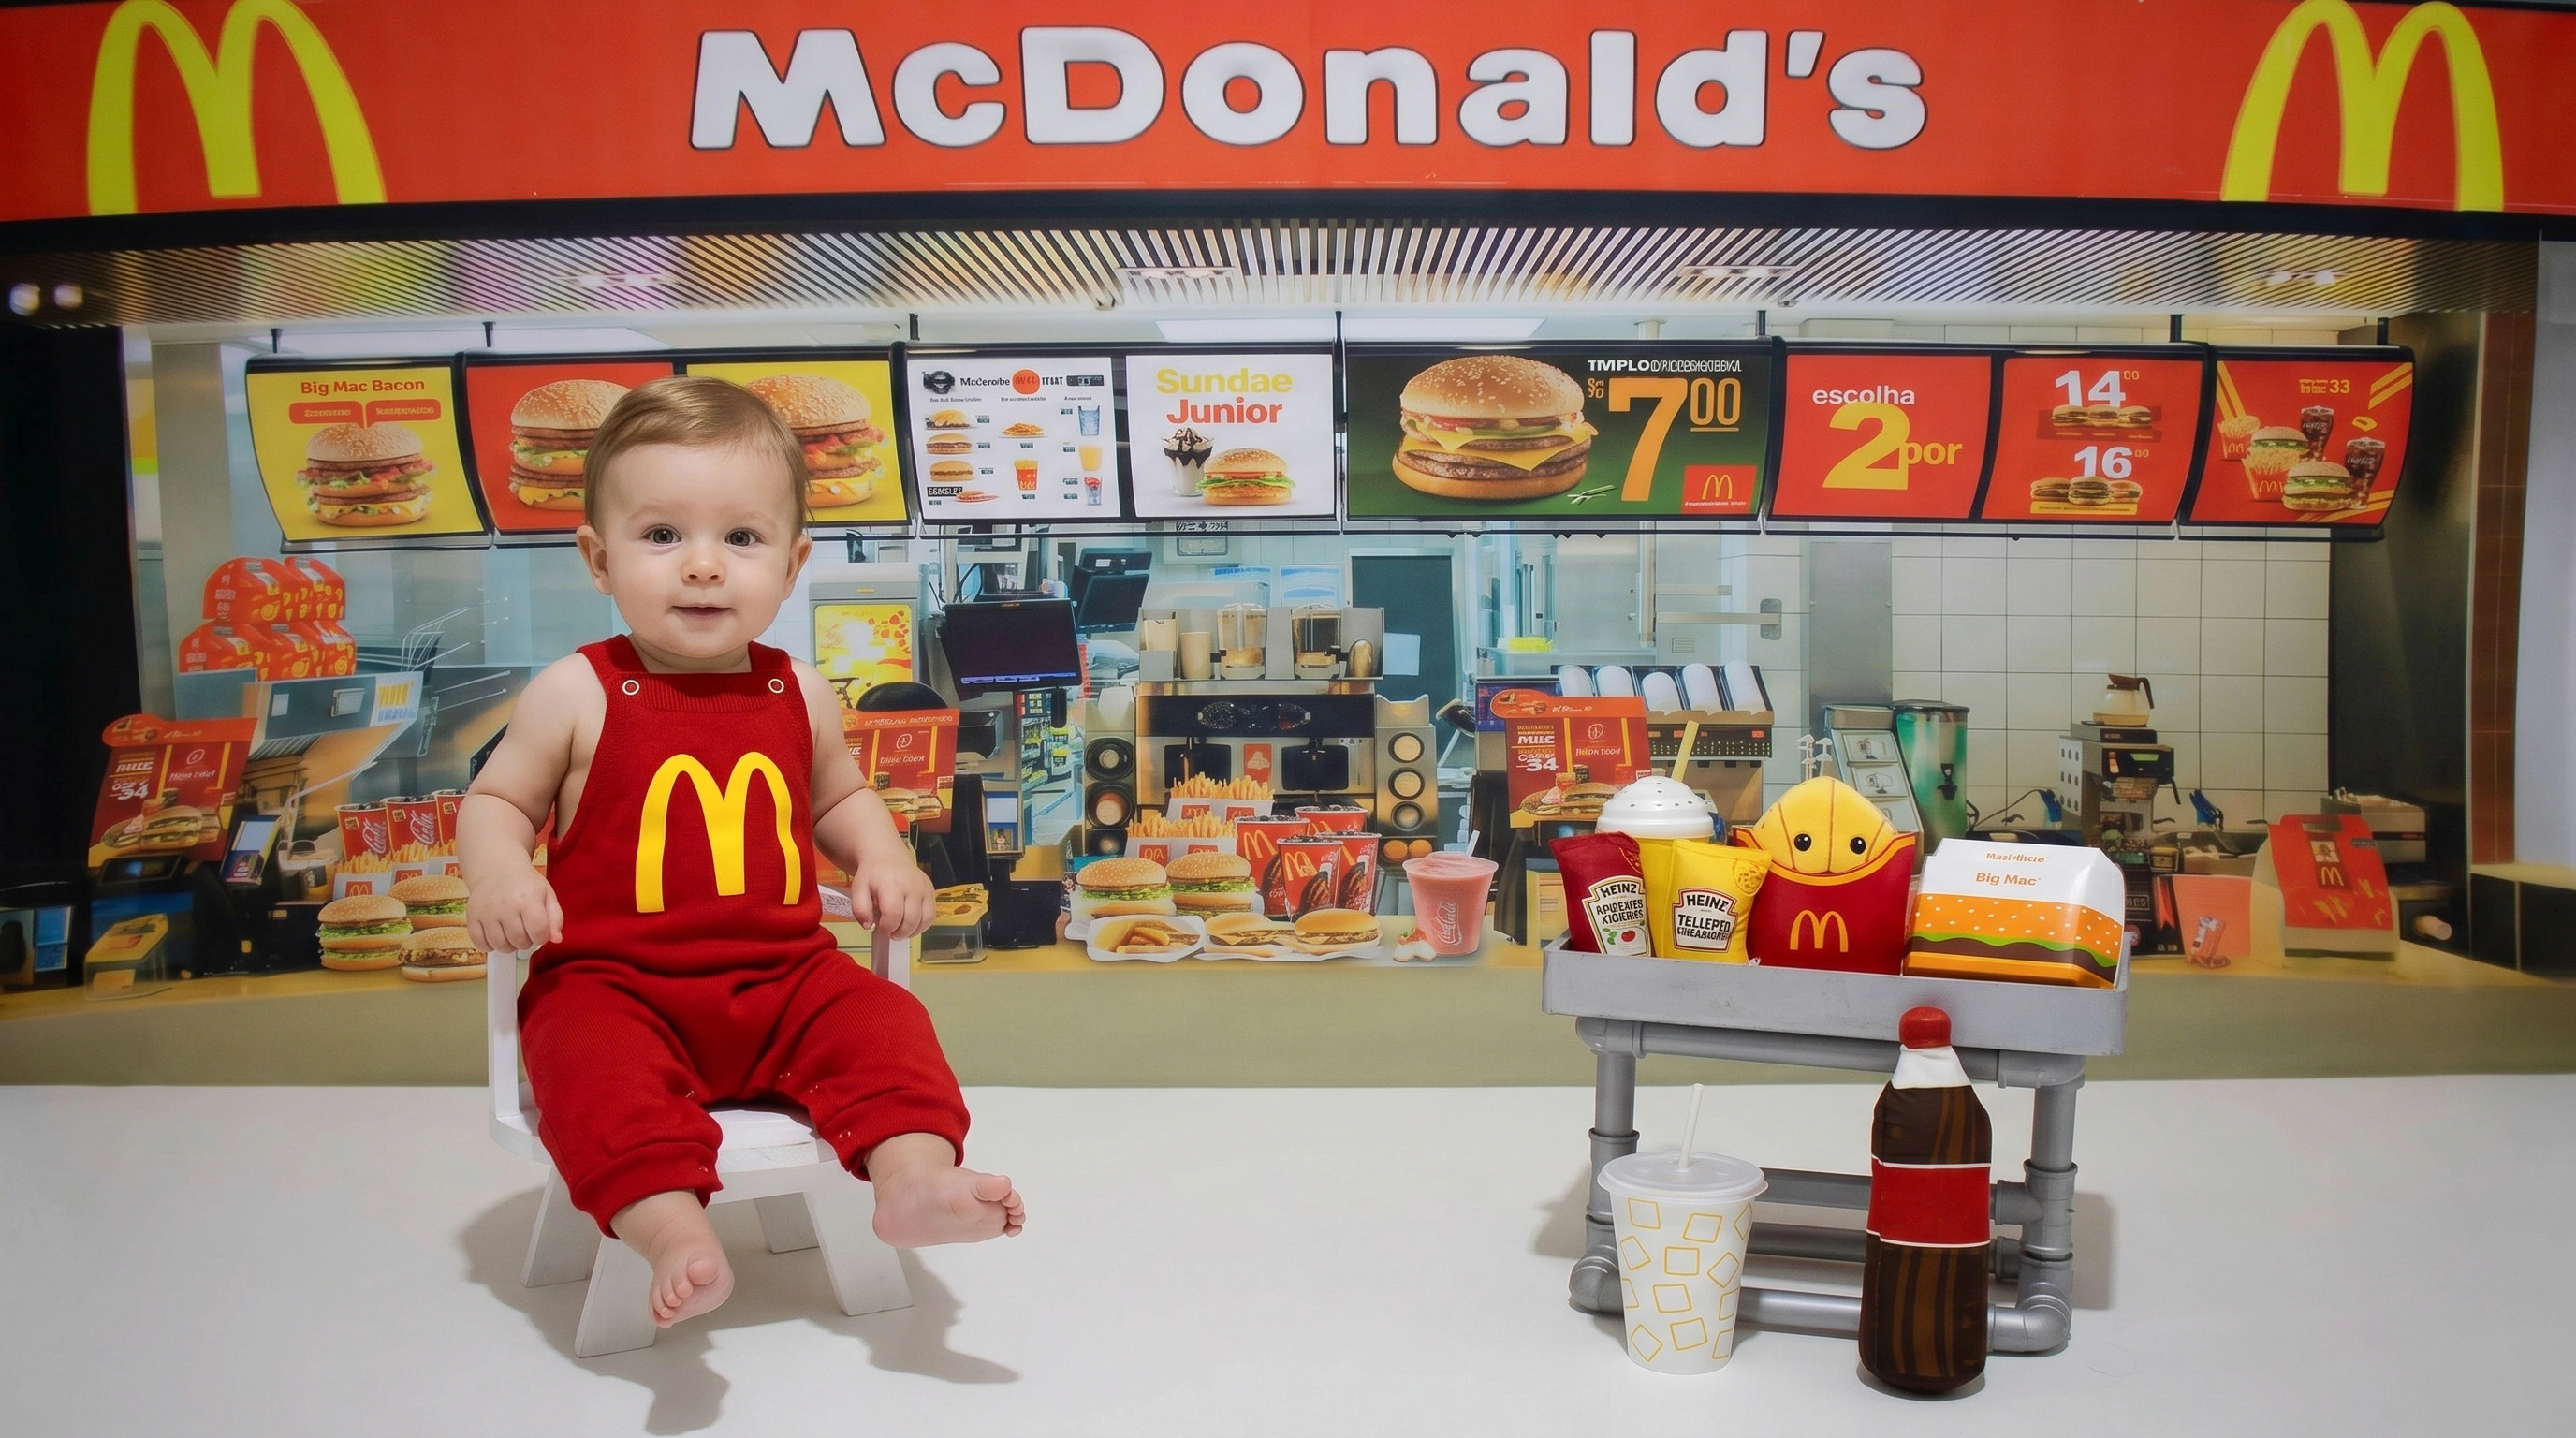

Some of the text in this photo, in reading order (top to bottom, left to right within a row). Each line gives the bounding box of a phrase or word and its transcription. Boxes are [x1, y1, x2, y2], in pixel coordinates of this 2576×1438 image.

[691, 26, 1926, 150] McDonald's
[300, 379, 425, 396] Big Mac Bacon
[1156, 367, 1293, 394] Sundae
[2055, 370, 2126, 408] 14
[2329, 379, 2350, 394] 33
[1812, 385, 1915, 404] escolha
[1166, 396, 1283, 424] Junior
[1608, 377, 1741, 502] 7 00
[1822, 403, 1963, 490] 2 por
[2074, 446, 2133, 479] 16
[1600, 883, 1637, 899] HEINZ
[1976, 873, 2037, 886] Big Mac
[1686, 894, 1729, 913] HEINZ
